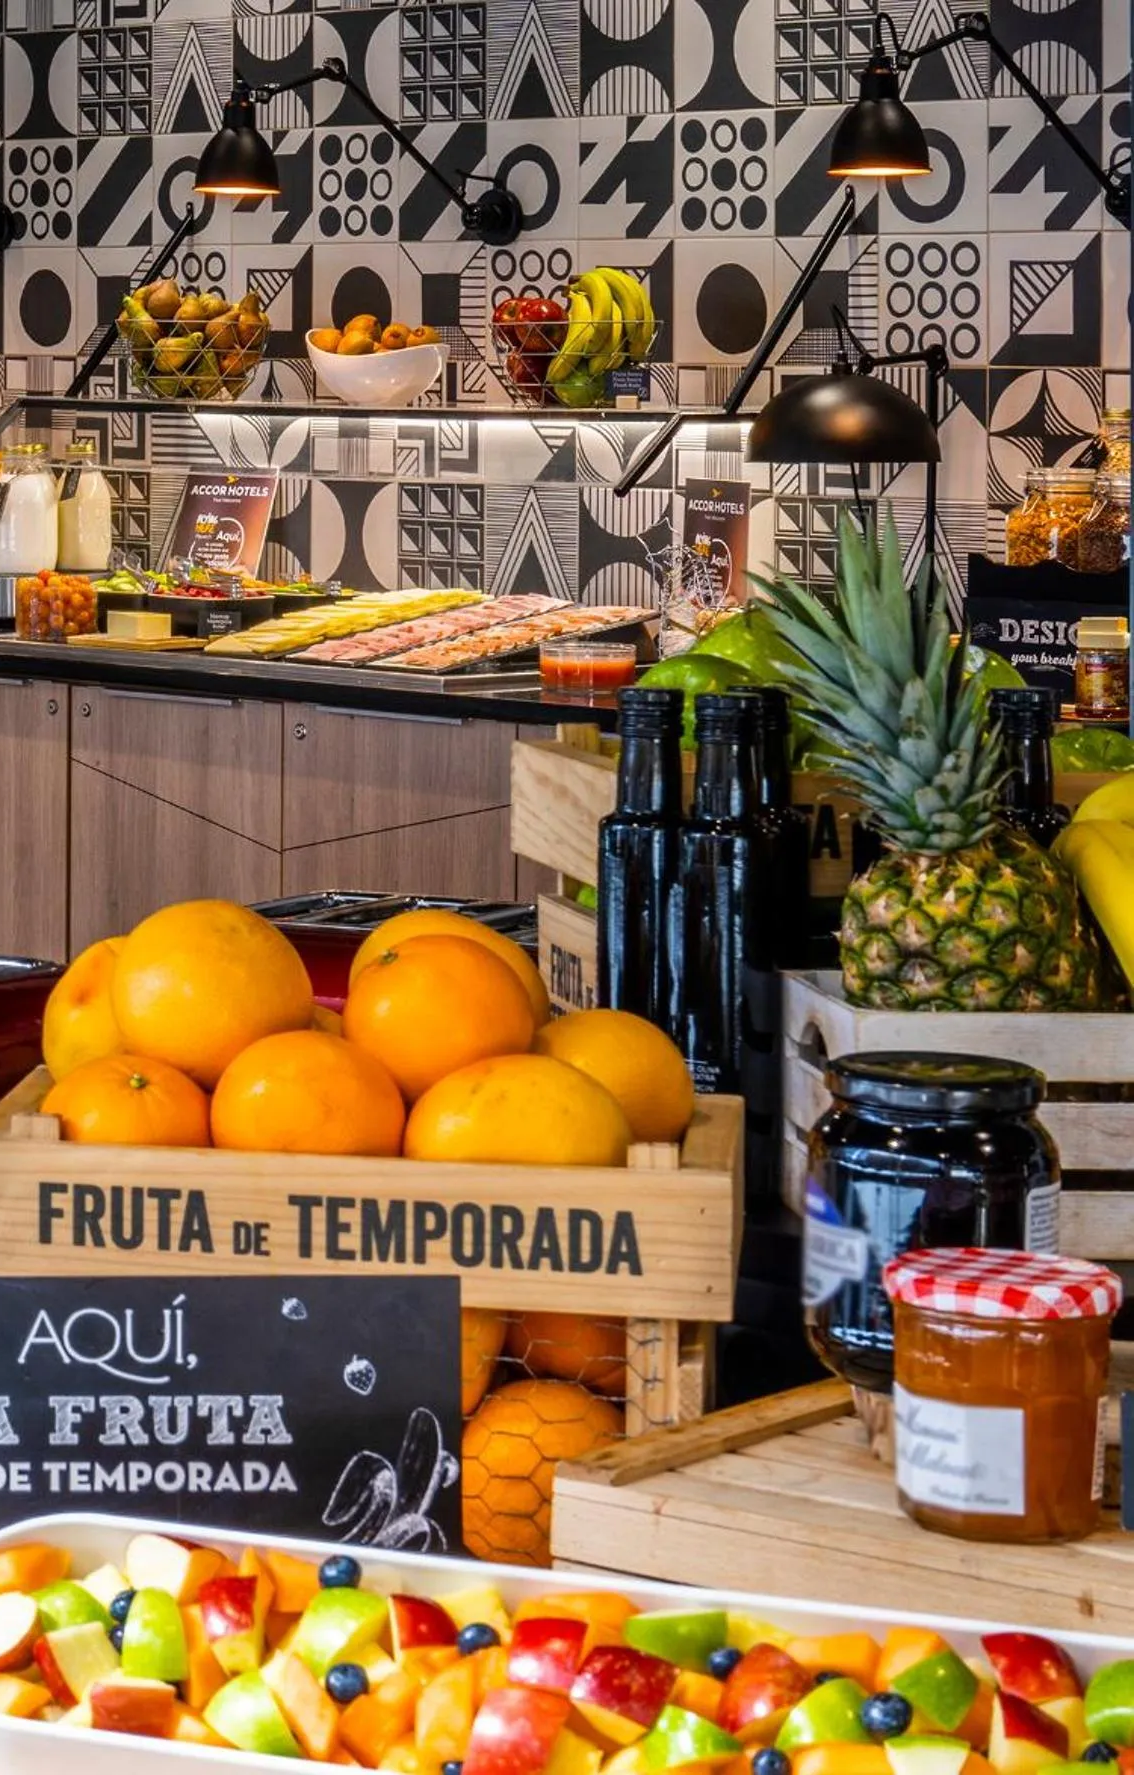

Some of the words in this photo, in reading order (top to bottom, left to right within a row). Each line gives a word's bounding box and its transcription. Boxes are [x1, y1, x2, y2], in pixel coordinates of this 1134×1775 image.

[1011, 653, 1039, 666] your
[38, 1181, 214, 1254] FRUTA
[232, 1220, 271, 1257] DE
[287, 1194, 644, 1277] TEMPORADA
[17, 1293, 198, 1384] AQUÍ,
[48, 1394, 293, 1446] FRUTA
[42, 1461, 299, 1493] TEMPORADA
